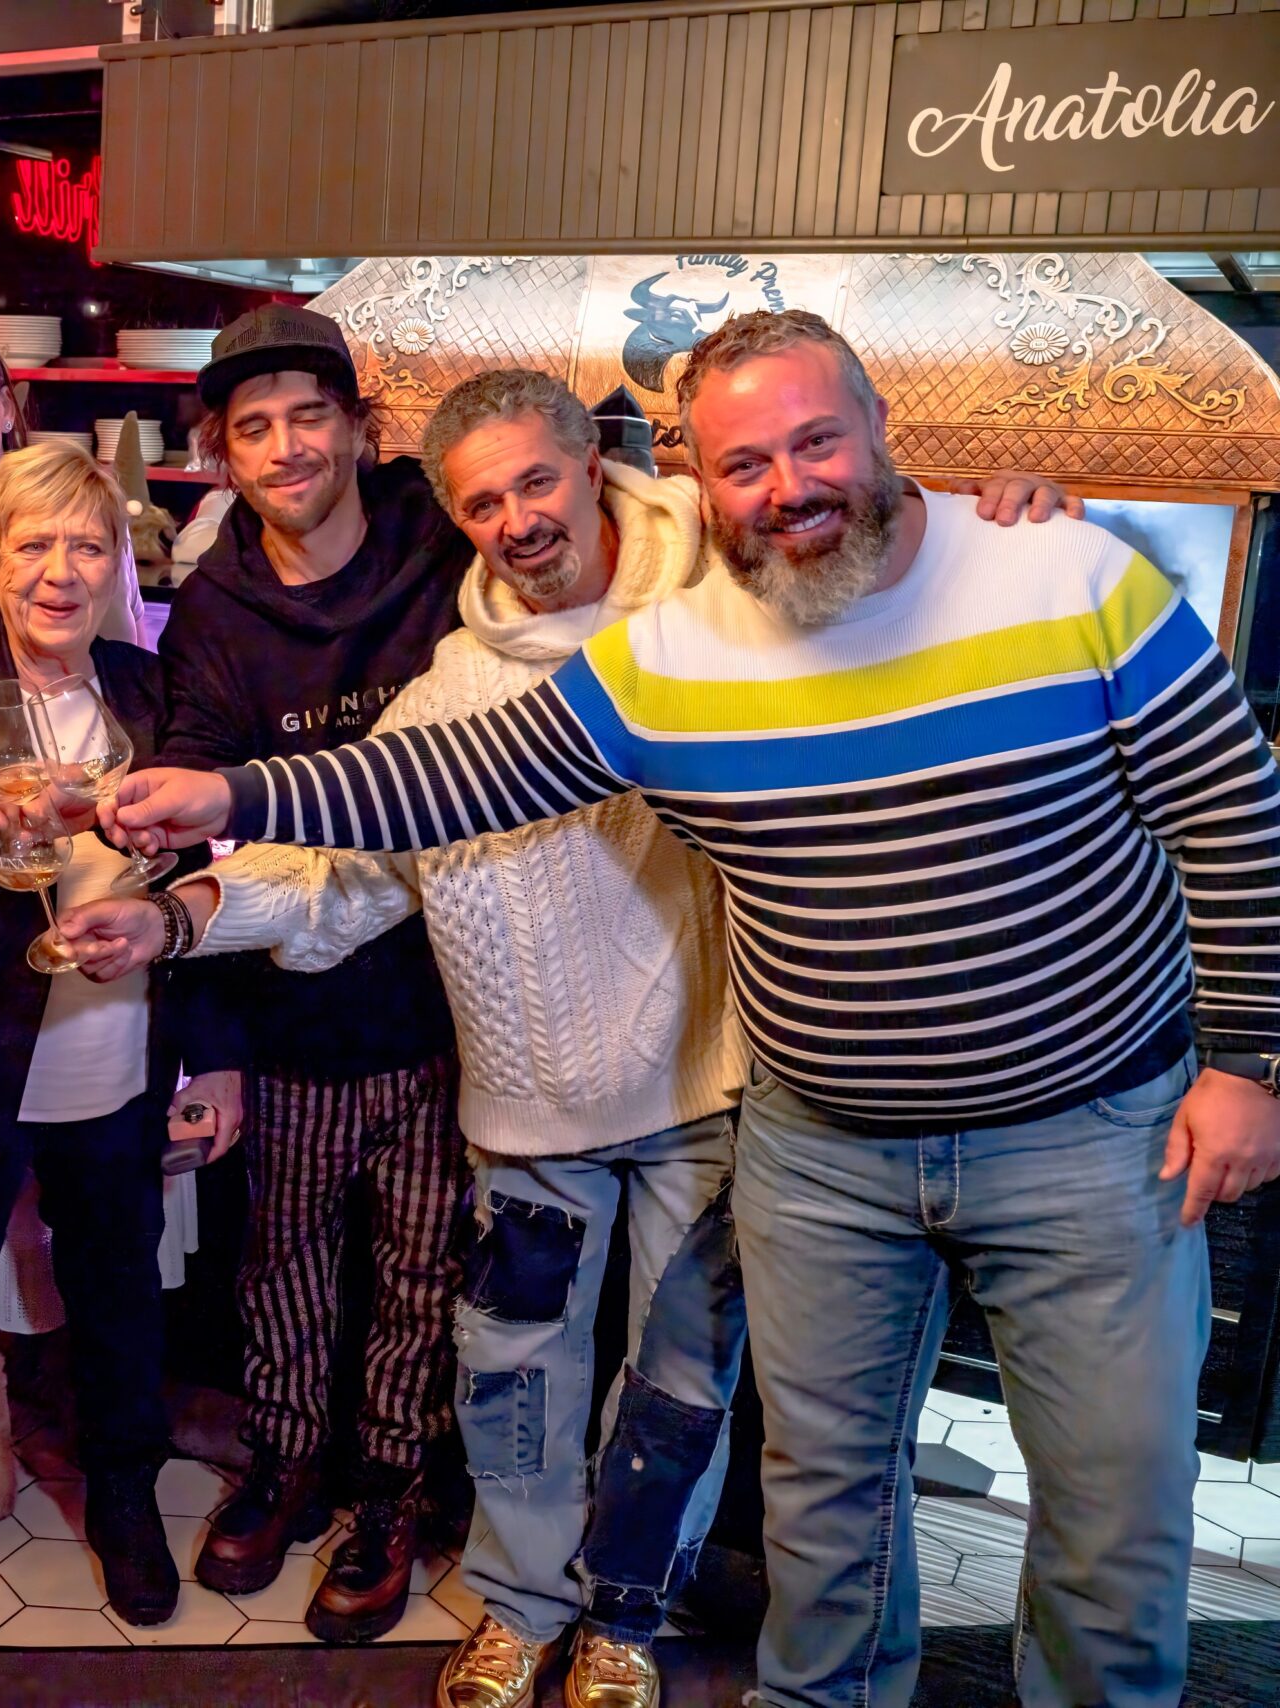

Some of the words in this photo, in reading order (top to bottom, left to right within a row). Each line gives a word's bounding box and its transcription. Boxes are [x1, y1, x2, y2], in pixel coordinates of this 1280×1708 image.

[907, 61, 1277, 172] Anatolia
[280, 685, 403, 733] GIVNCH
[335, 714, 363, 729] ARIS
